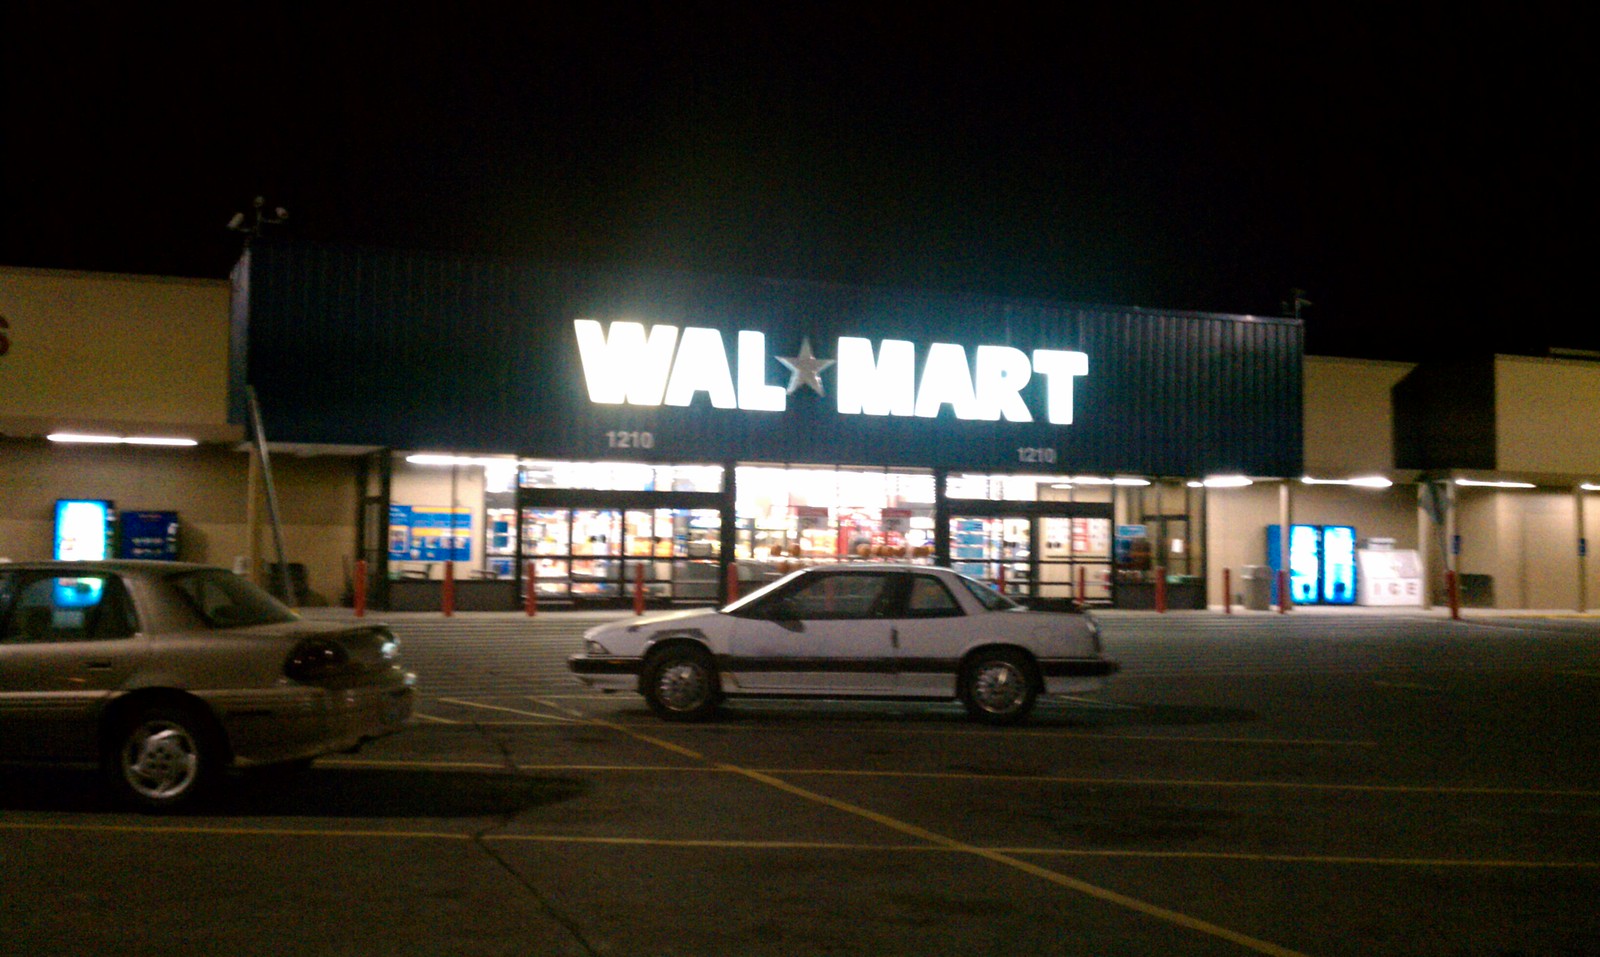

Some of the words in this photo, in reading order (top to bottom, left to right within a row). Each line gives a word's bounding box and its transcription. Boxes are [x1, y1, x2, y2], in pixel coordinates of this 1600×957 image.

[606, 430, 654, 450] 1210
[1017, 447, 1057, 464] 1210
[1373, 581, 1418, 596] ICE
